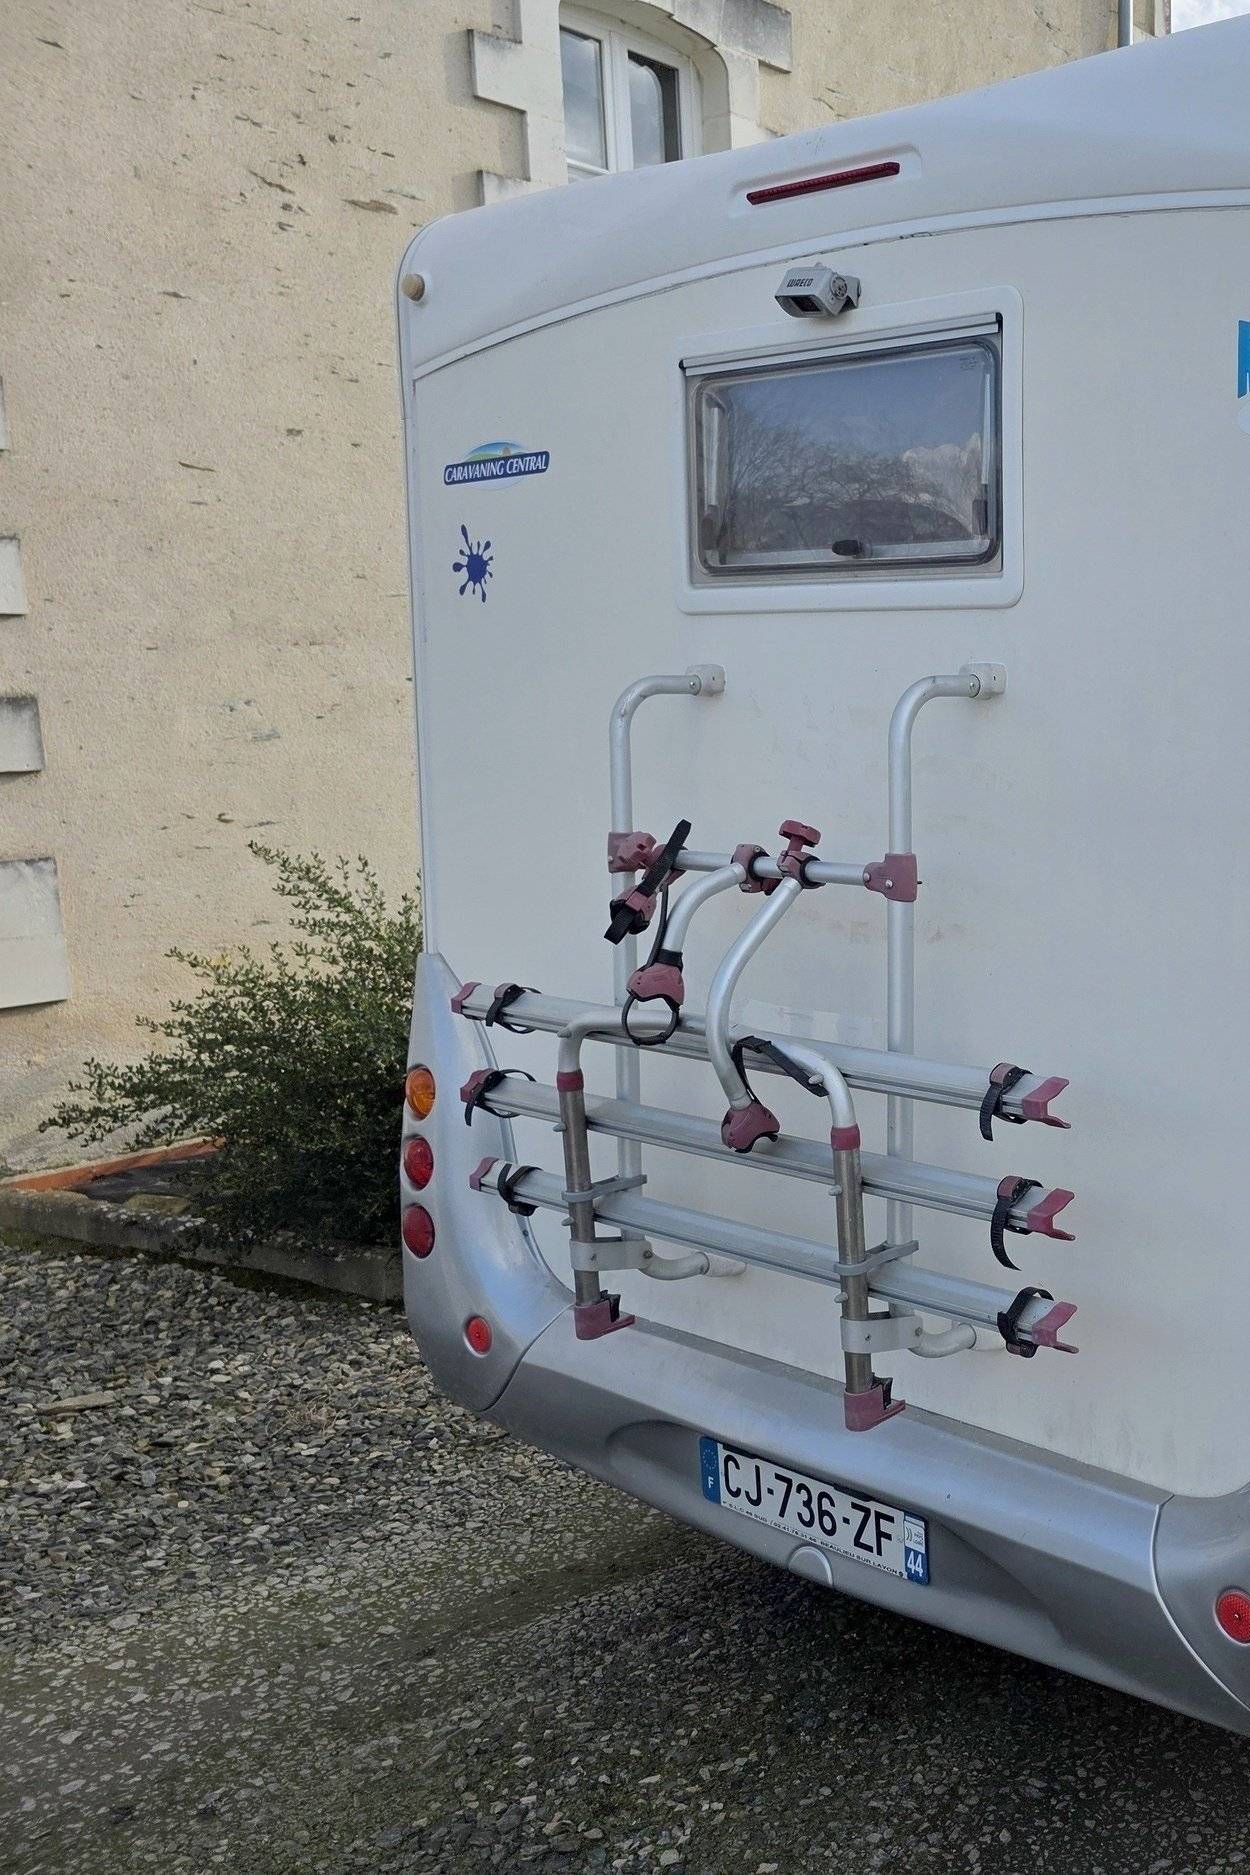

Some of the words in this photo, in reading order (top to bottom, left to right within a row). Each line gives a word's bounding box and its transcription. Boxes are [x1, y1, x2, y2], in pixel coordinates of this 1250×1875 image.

[787, 278, 814, 288] WAECO
[445, 460, 505, 482] CARAVANING
[506, 454, 547, 474] CENTRAL
[707, 1476, 714, 1489] F
[723, 1454, 895, 1557] CJ-736-ZF
[907, 1550, 924, 1577] 44
